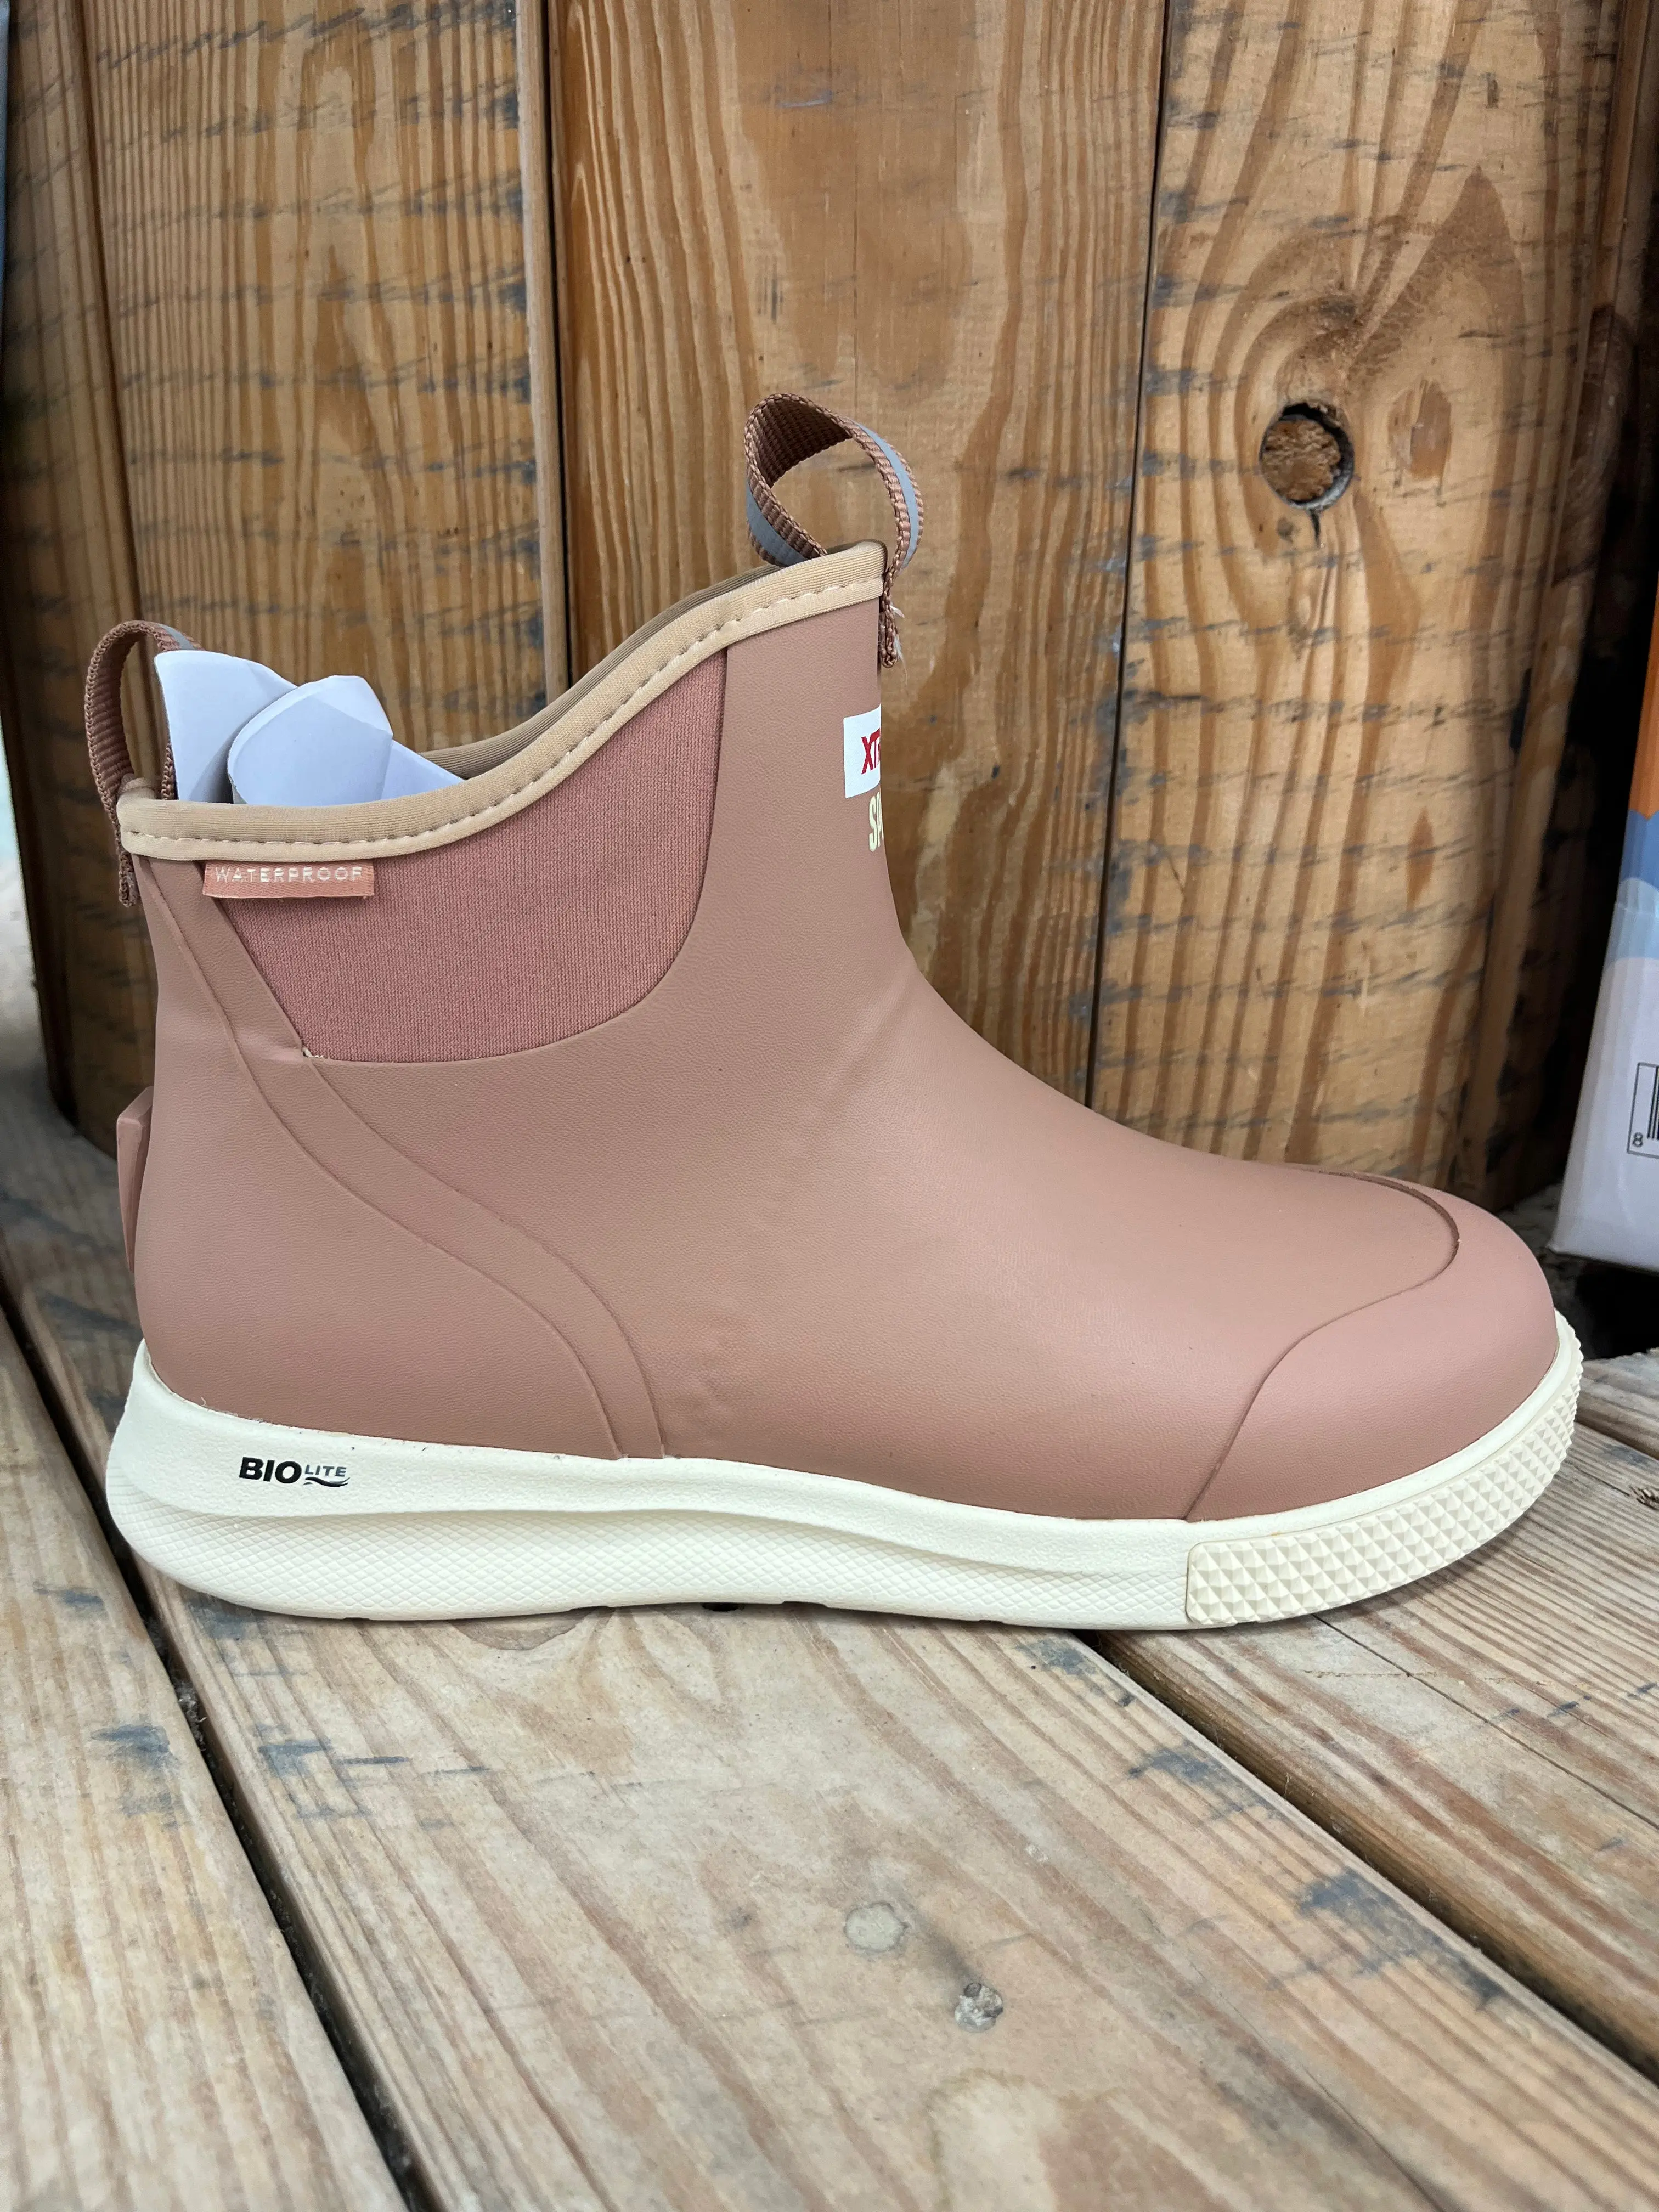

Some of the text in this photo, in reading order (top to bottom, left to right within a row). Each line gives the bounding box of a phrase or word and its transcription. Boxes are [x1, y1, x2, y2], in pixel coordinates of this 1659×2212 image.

[861, 728, 880, 774] XT
[869, 792, 884, 852] SP
[215, 866, 362, 883] WATERPROOF
[1633, 1132, 1643, 1147] 8
